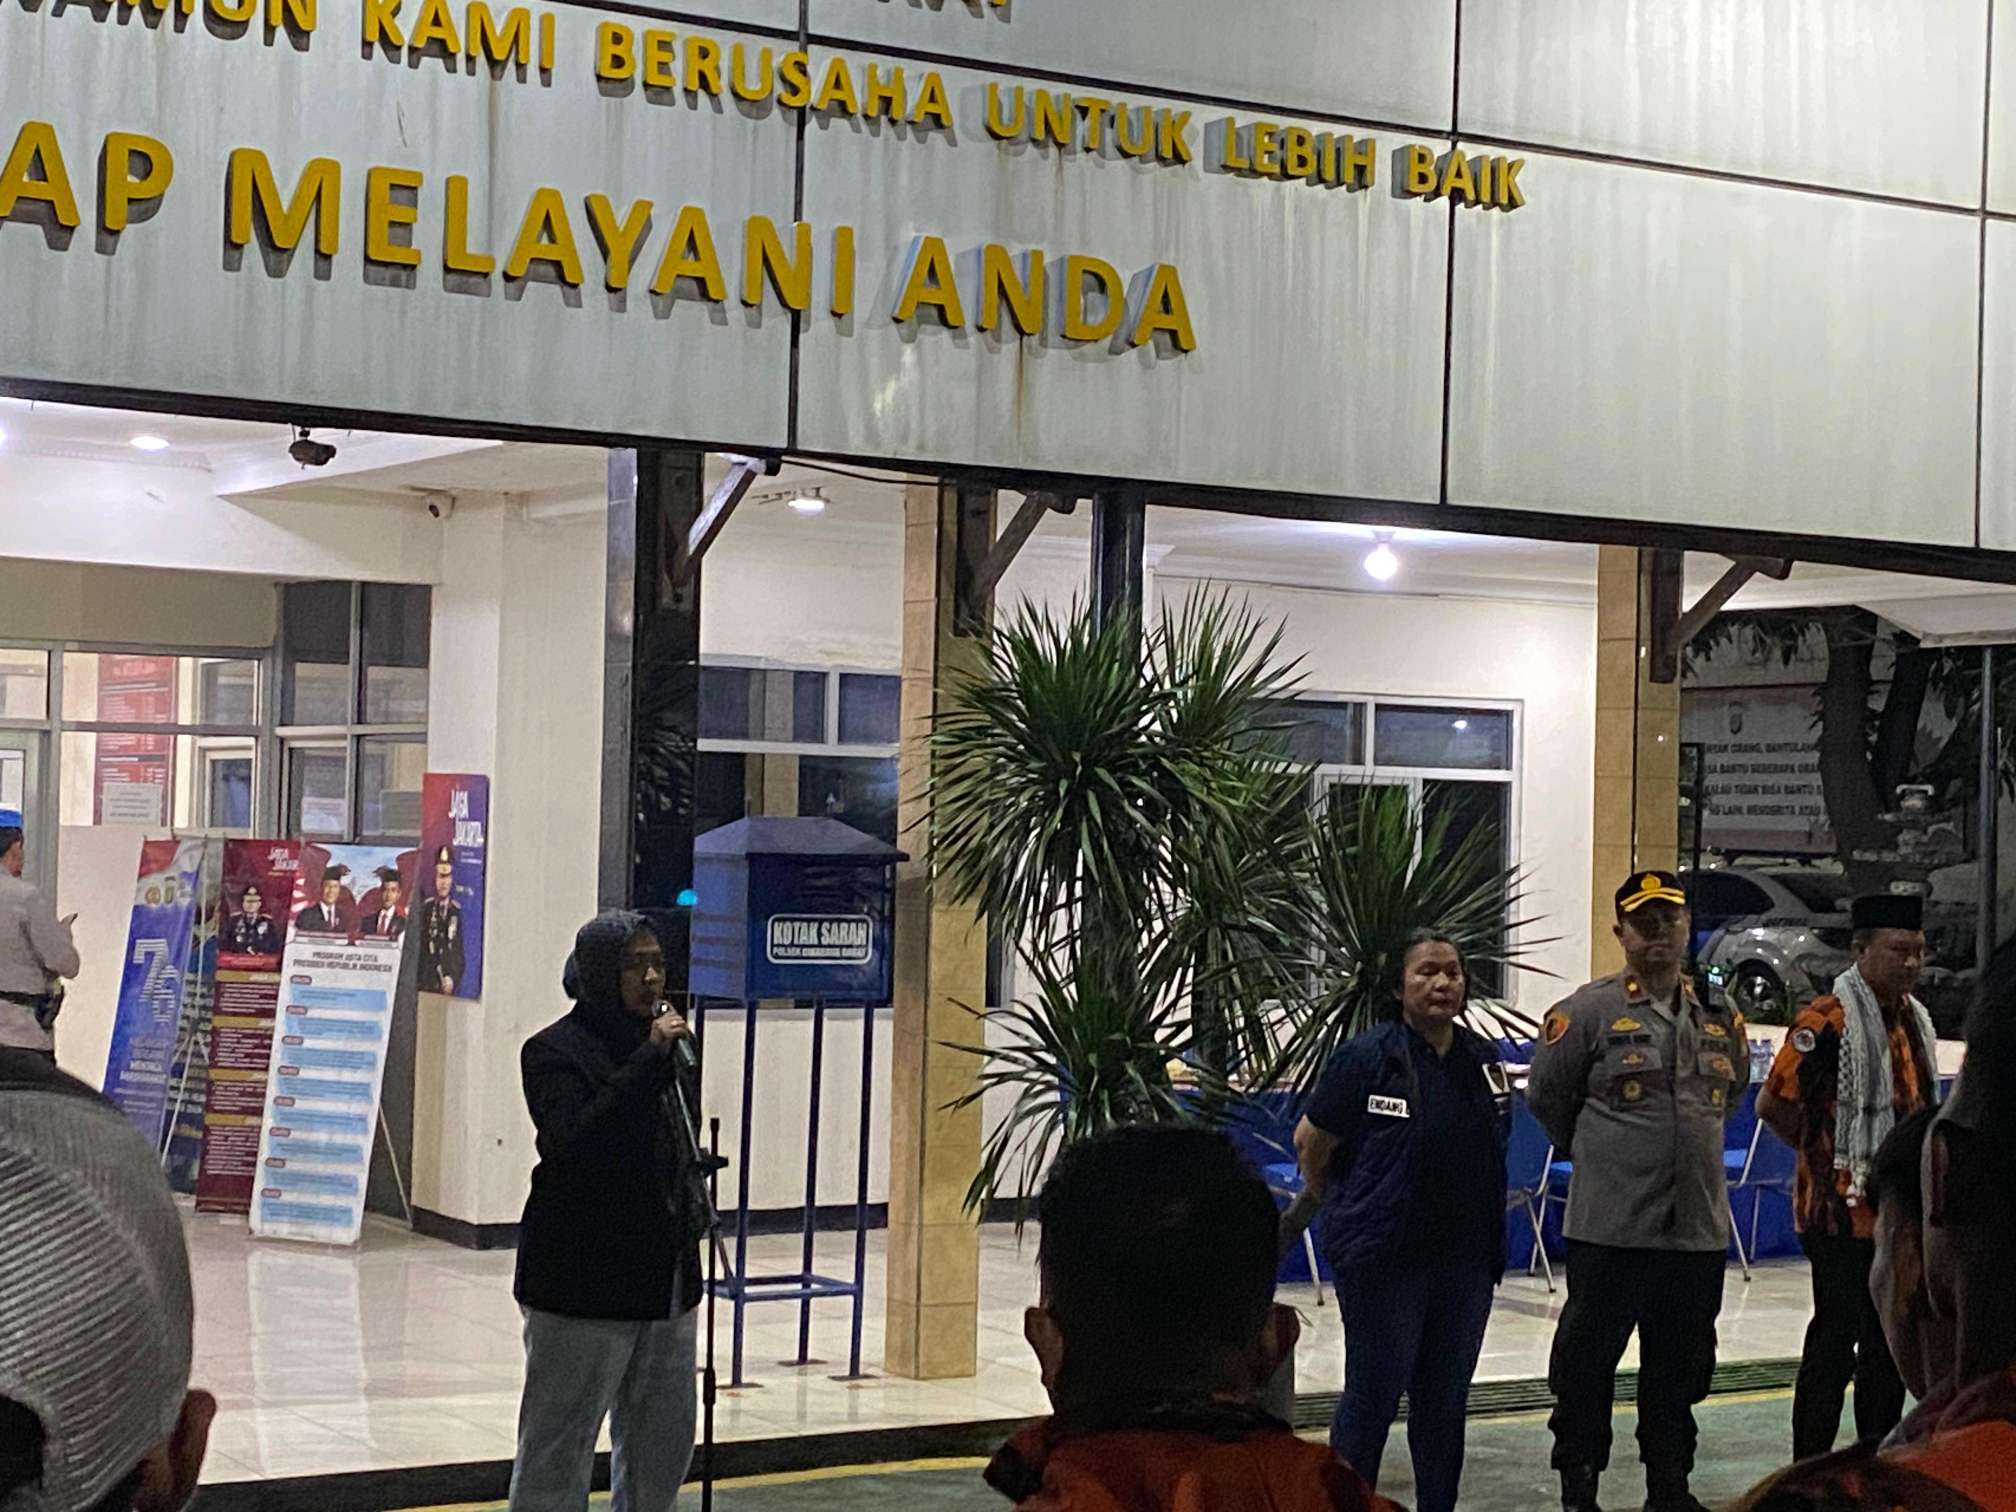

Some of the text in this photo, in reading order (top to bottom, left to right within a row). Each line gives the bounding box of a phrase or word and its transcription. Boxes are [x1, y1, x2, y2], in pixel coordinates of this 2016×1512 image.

[364, 0, 556, 70] KAMI
[596, 20, 952, 128] BERUSAHA
[985, 81, 1193, 165] UNTUK
[1221, 115, 1376, 190] LEBIH
[1405, 143, 1526, 208] BAIK
[228, 147, 855, 317] MELAYANI
[893, 234, 1198, 353] ANDA
[773, 921, 867, 946] KOTAK SARAN
